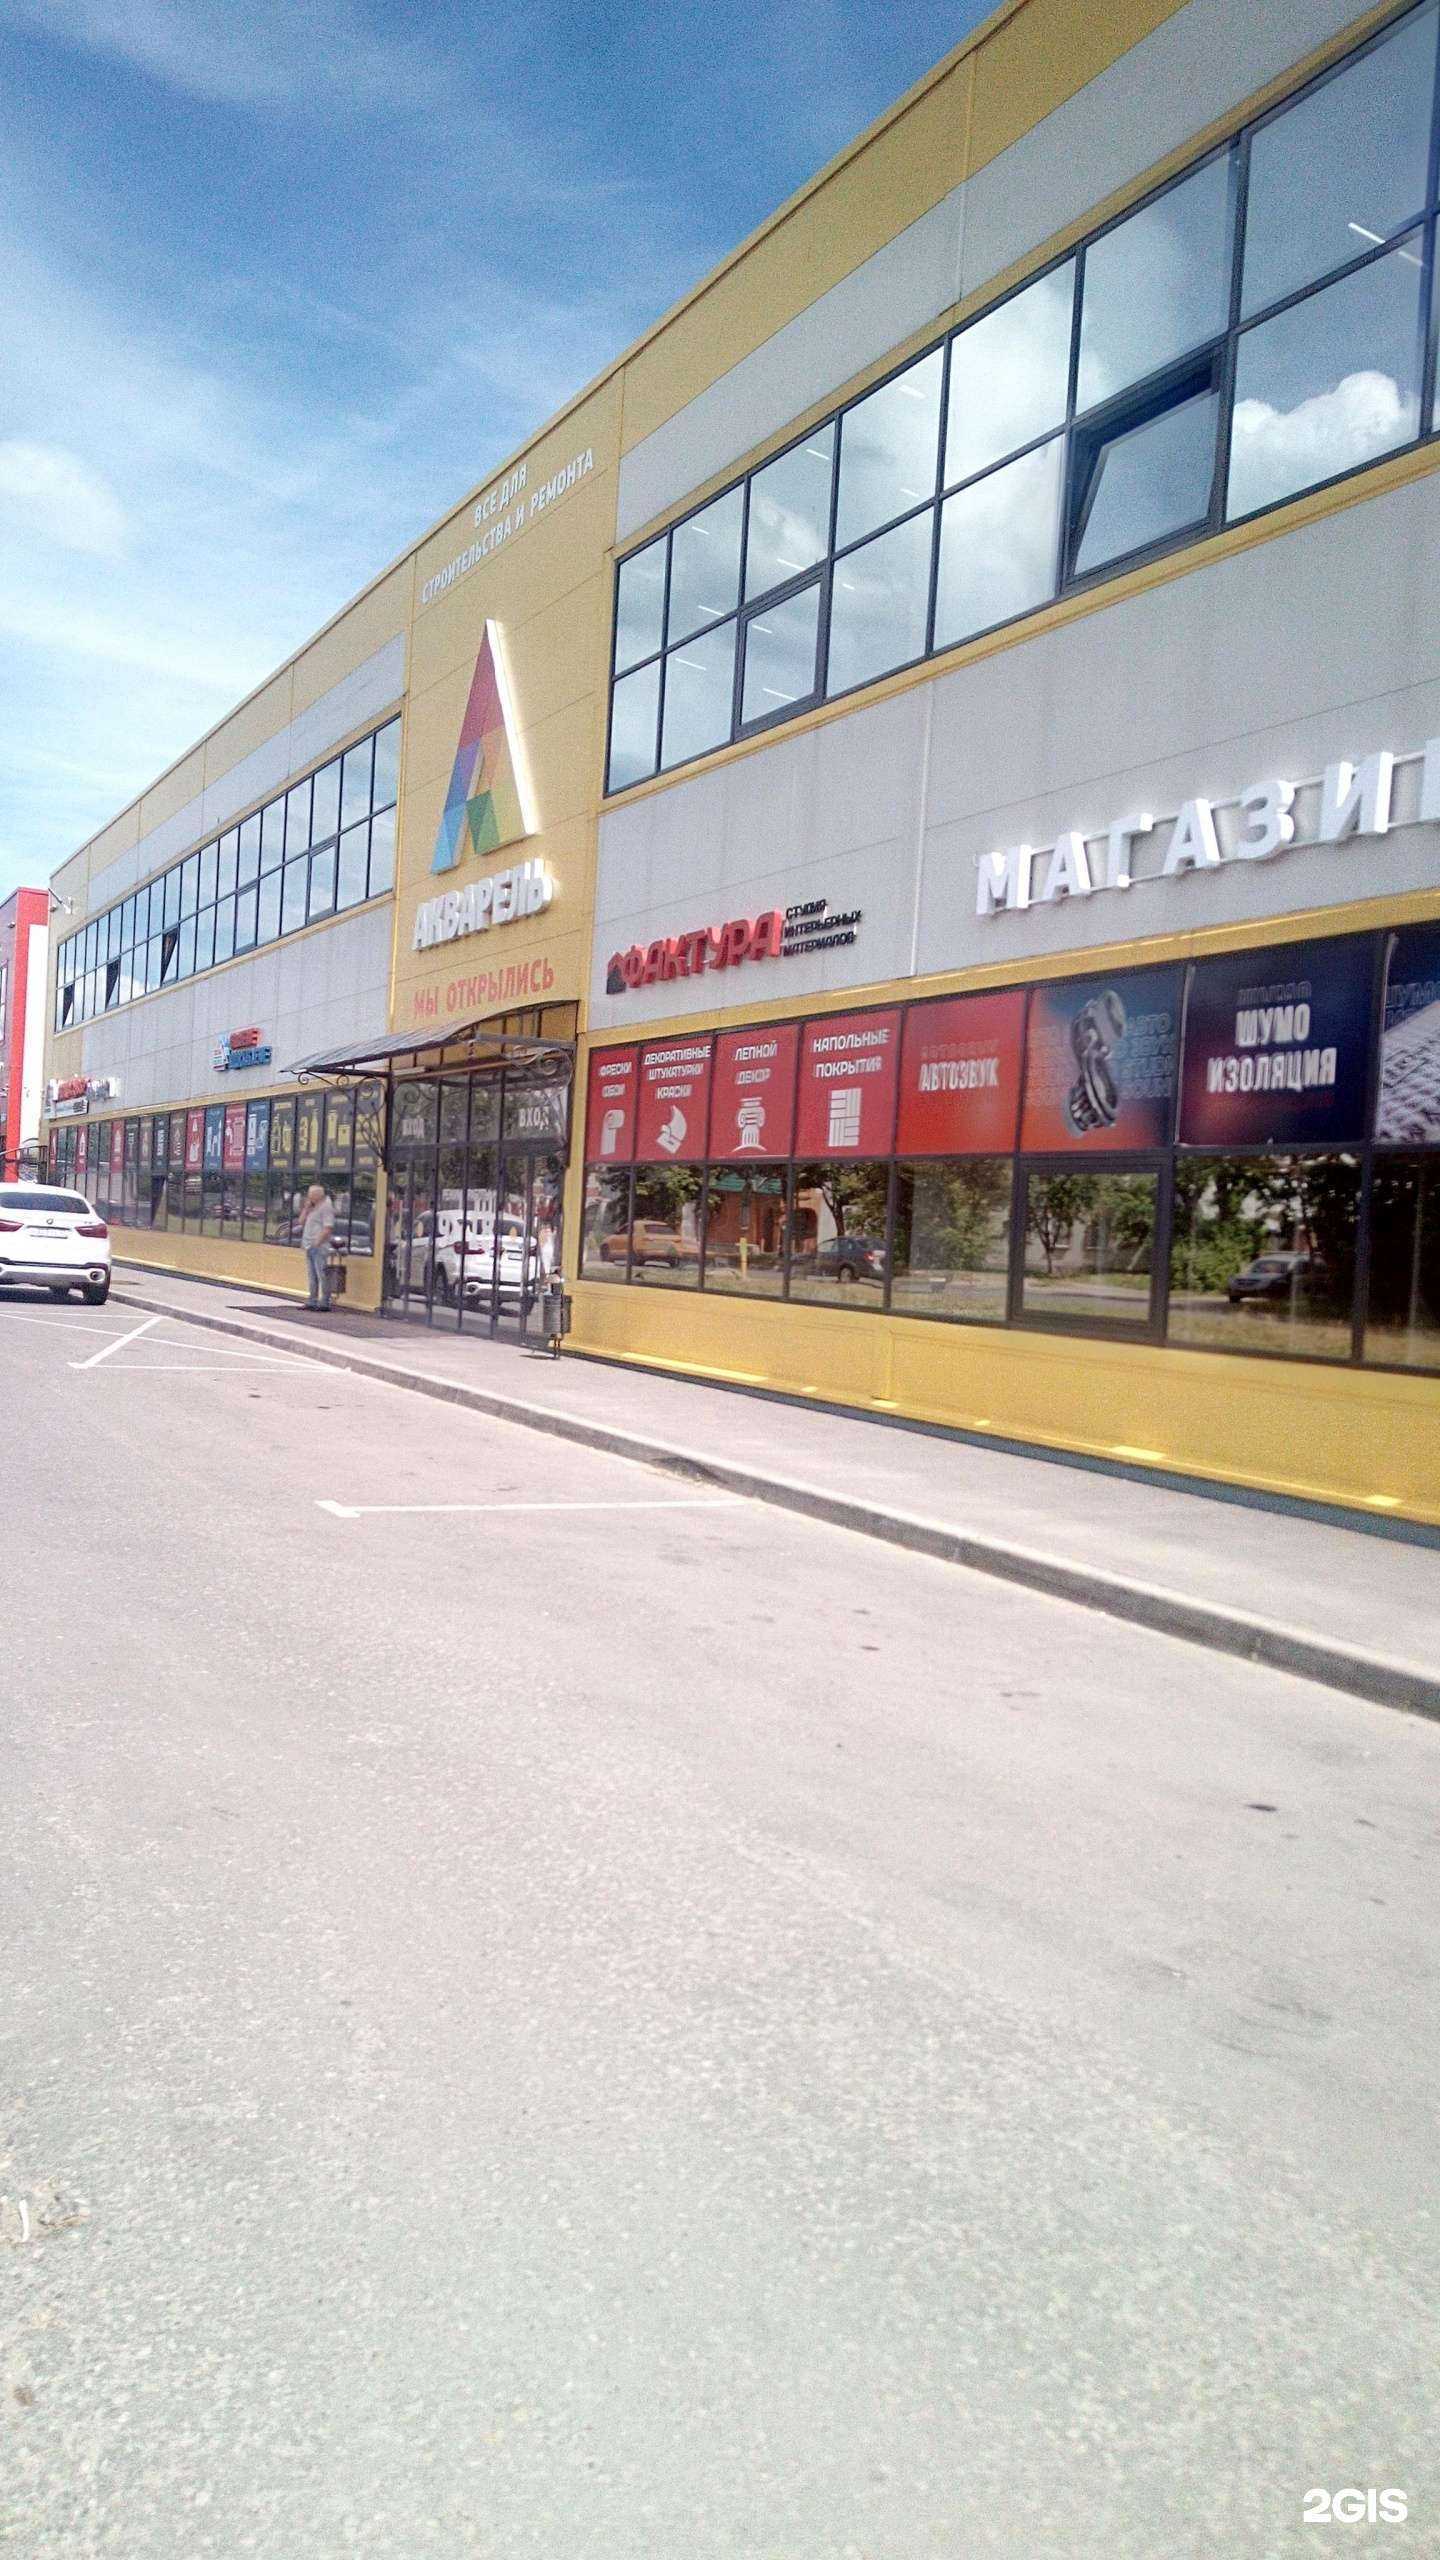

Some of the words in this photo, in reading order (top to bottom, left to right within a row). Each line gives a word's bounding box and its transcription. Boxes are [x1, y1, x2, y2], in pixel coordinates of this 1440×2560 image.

[475, 489, 498, 529] ВСЕ
[500, 463, 528, 512] ДЛЯ
[421, 515, 512, 605] СТРОИТЕЛЬСТВА
[514, 505, 525, 530] И
[529, 447, 593, 517] РЕМОНТА
[975, 736, 1440, 915] МАГАЗИ
[412, 857, 554, 951] АКВАРЕЛЬ
[785, 898, 827, 920] СТУДИЯ
[784, 909, 862, 939] ИНТЕРЬЕРНЫХ
[621, 908, 784, 988] ФАКТУРА
[783, 930, 857, 957] МАТЕРИАЛОВ
[413, 985, 440, 1018] МЫ
[446, 957, 555, 1012] ОТКРЫЛИСЬ
[1235, 1002, 1311, 1048] ШУМО
[643, 1045, 712, 1065] ДЕКОРАТИВНЫЕ
[734, 1039, 777, 1061] ЛЕПНОЙ
[813, 1028, 891, 1053] НАПОЛЬНЫЕ
[647, 1063, 704, 1081] ШТУКАТУРКИ
[736, 1067, 771, 1085] ДЕКОР
[814, 1056, 883, 1079] ПОКРЫТИЯ
[919, 1057, 999, 1092] АВТОЗВУК
[1206, 1047, 1337, 1093] ИЗОЛЯЦИЯ
[656, 1084, 693, 1100] КРАСКИ
